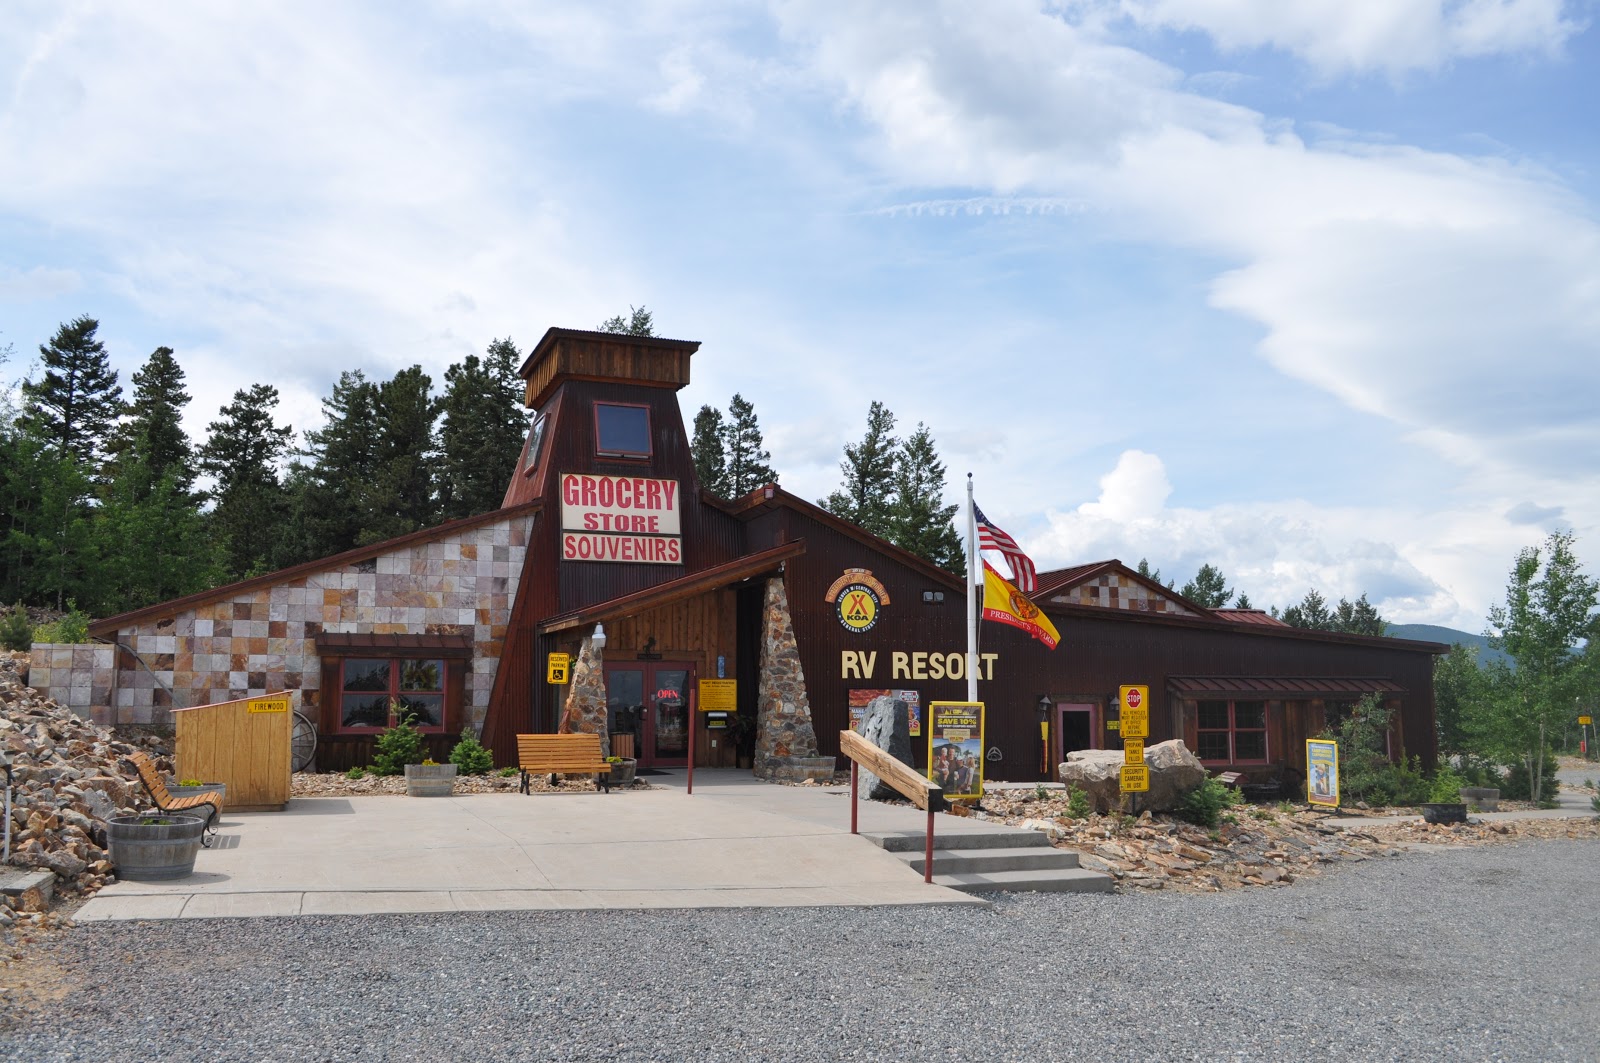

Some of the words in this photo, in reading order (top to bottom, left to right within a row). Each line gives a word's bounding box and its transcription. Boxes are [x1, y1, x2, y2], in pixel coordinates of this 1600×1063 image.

[563, 474, 676, 510] GROCERY
[583, 512, 660, 533] STORE
[564, 535, 680, 562] SOUVENIRS
[840, 620, 860, 633] GENERAL
[862, 620, 876, 633] STORE
[1032, 626, 1054, 645] AWARD
[841, 650, 877, 679] RV
[892, 651, 998, 681] RESORT
[657, 689, 679, 699] OPEN
[1127, 694, 1141, 703] STOP
